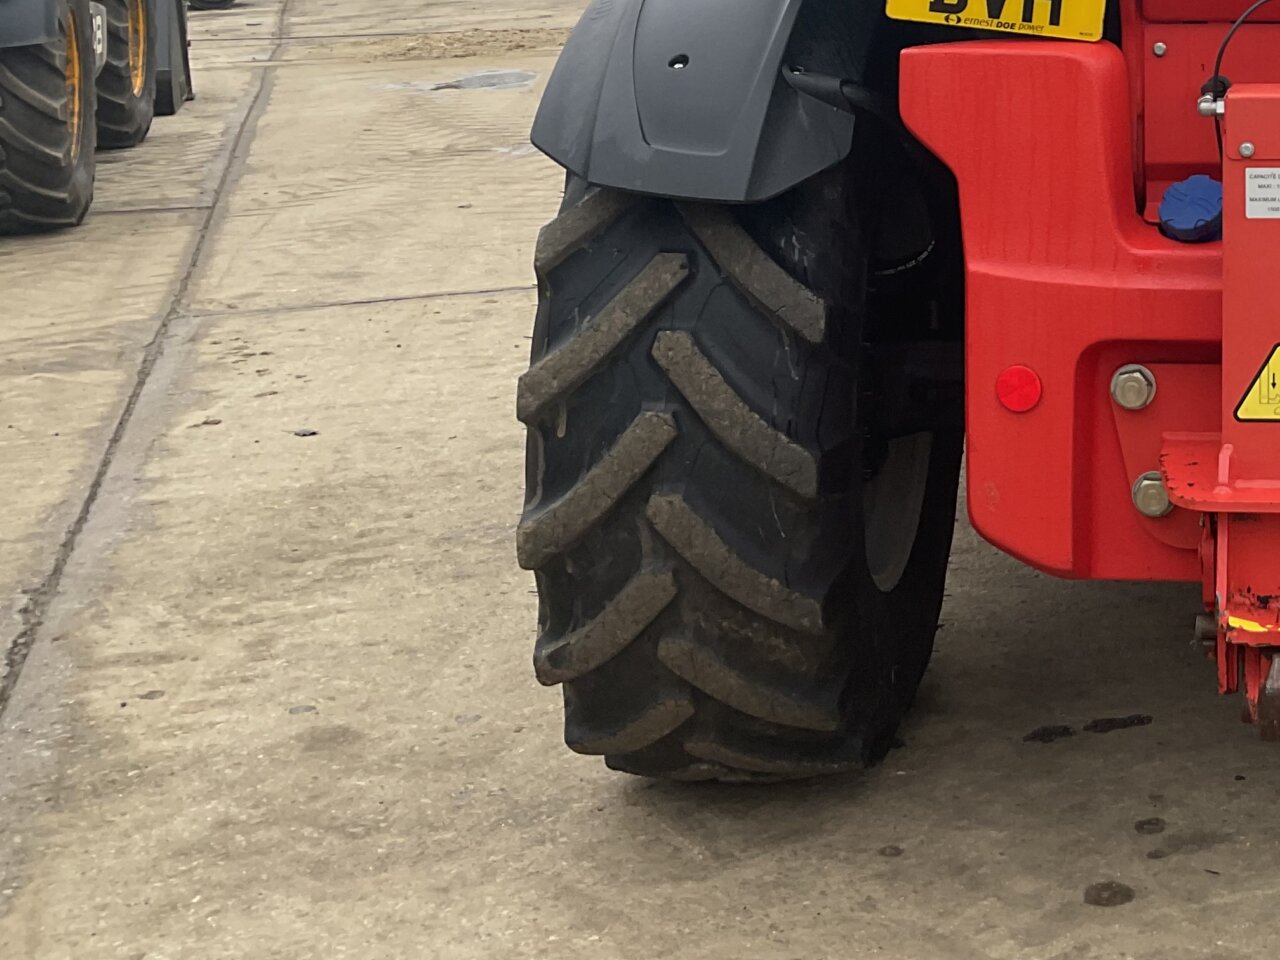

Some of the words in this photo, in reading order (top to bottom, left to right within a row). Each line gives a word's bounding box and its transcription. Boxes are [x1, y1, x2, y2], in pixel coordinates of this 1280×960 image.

[963, 17, 993, 27] ernest
[996, 21, 1016, 29] DOE
[1018, 23, 1044, 32] power
